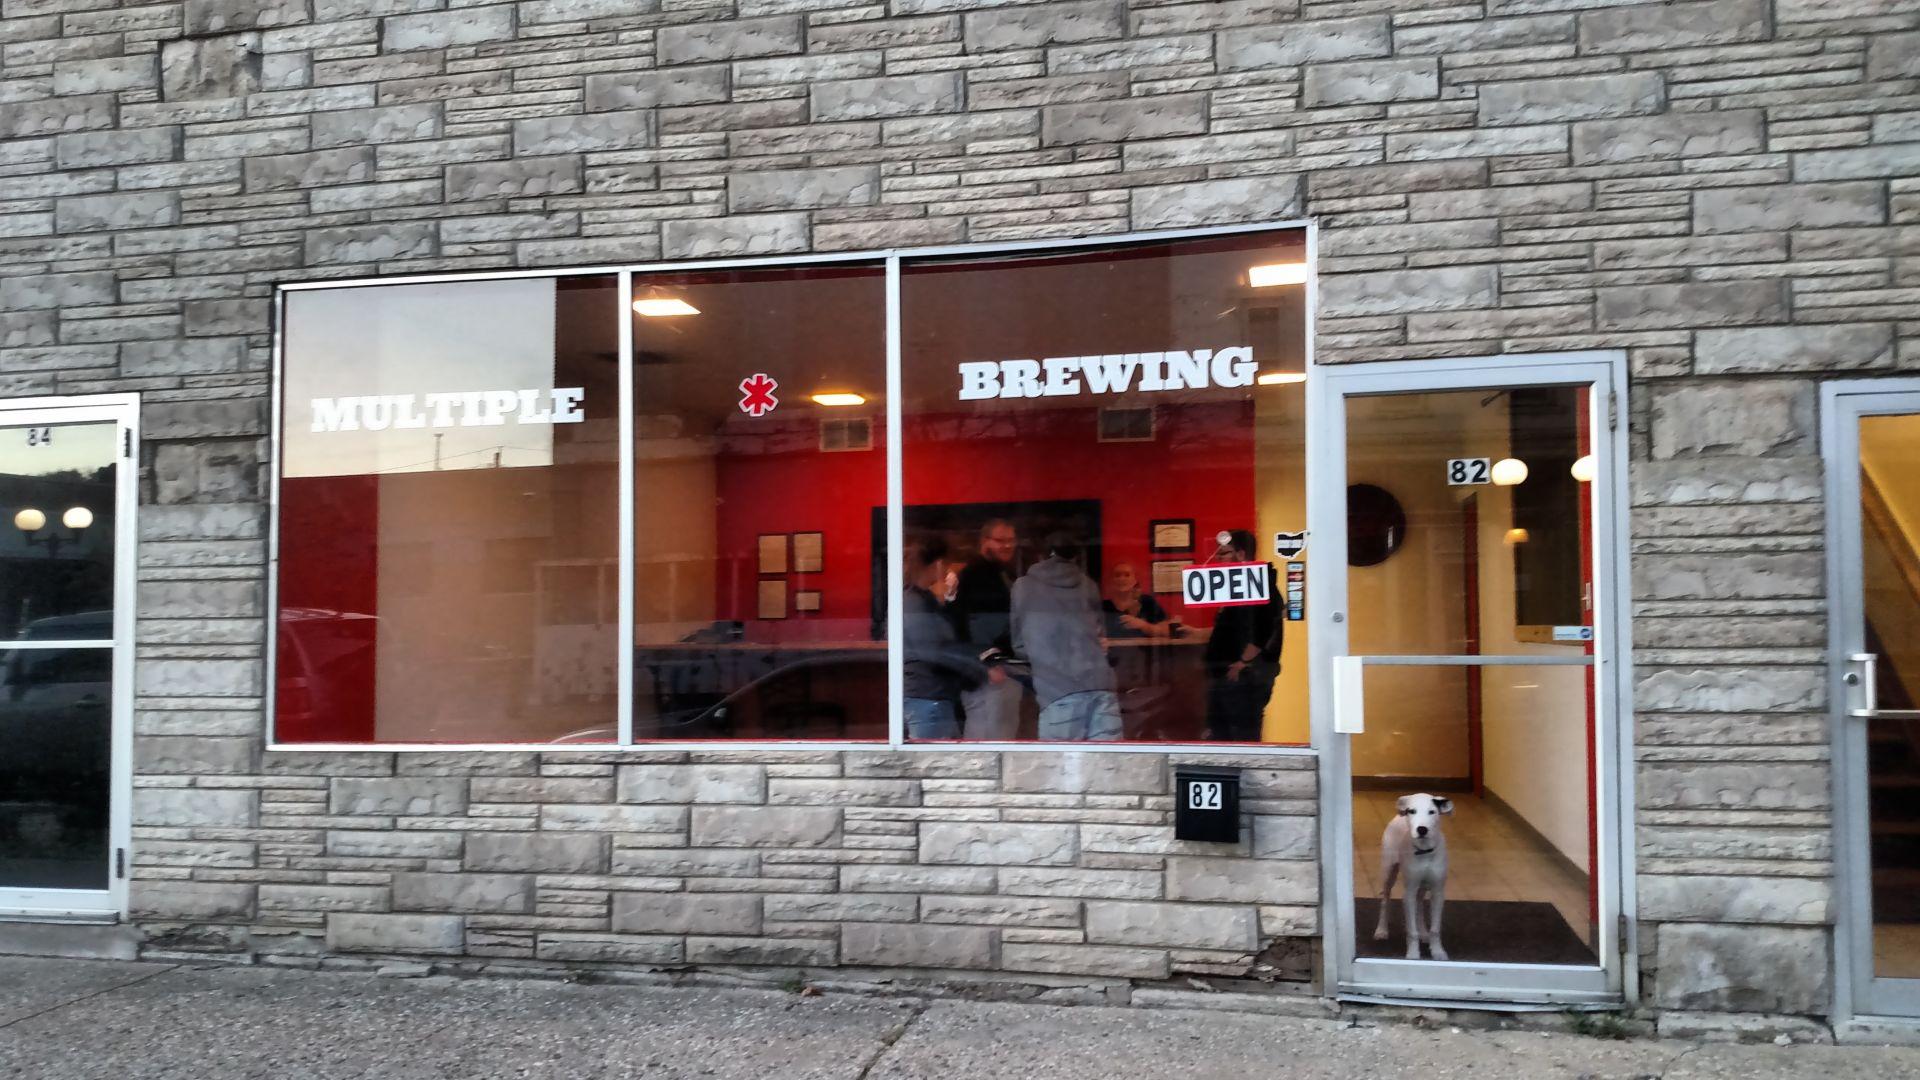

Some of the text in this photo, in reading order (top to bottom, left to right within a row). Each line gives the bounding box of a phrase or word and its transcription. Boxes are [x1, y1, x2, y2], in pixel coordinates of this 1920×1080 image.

[311, 346, 1258, 432] MULTIPLE BREWING
[1451, 460, 1487, 483] 82
[1188, 567, 1265, 602] OPEN
[1192, 783, 1219, 808] 82
